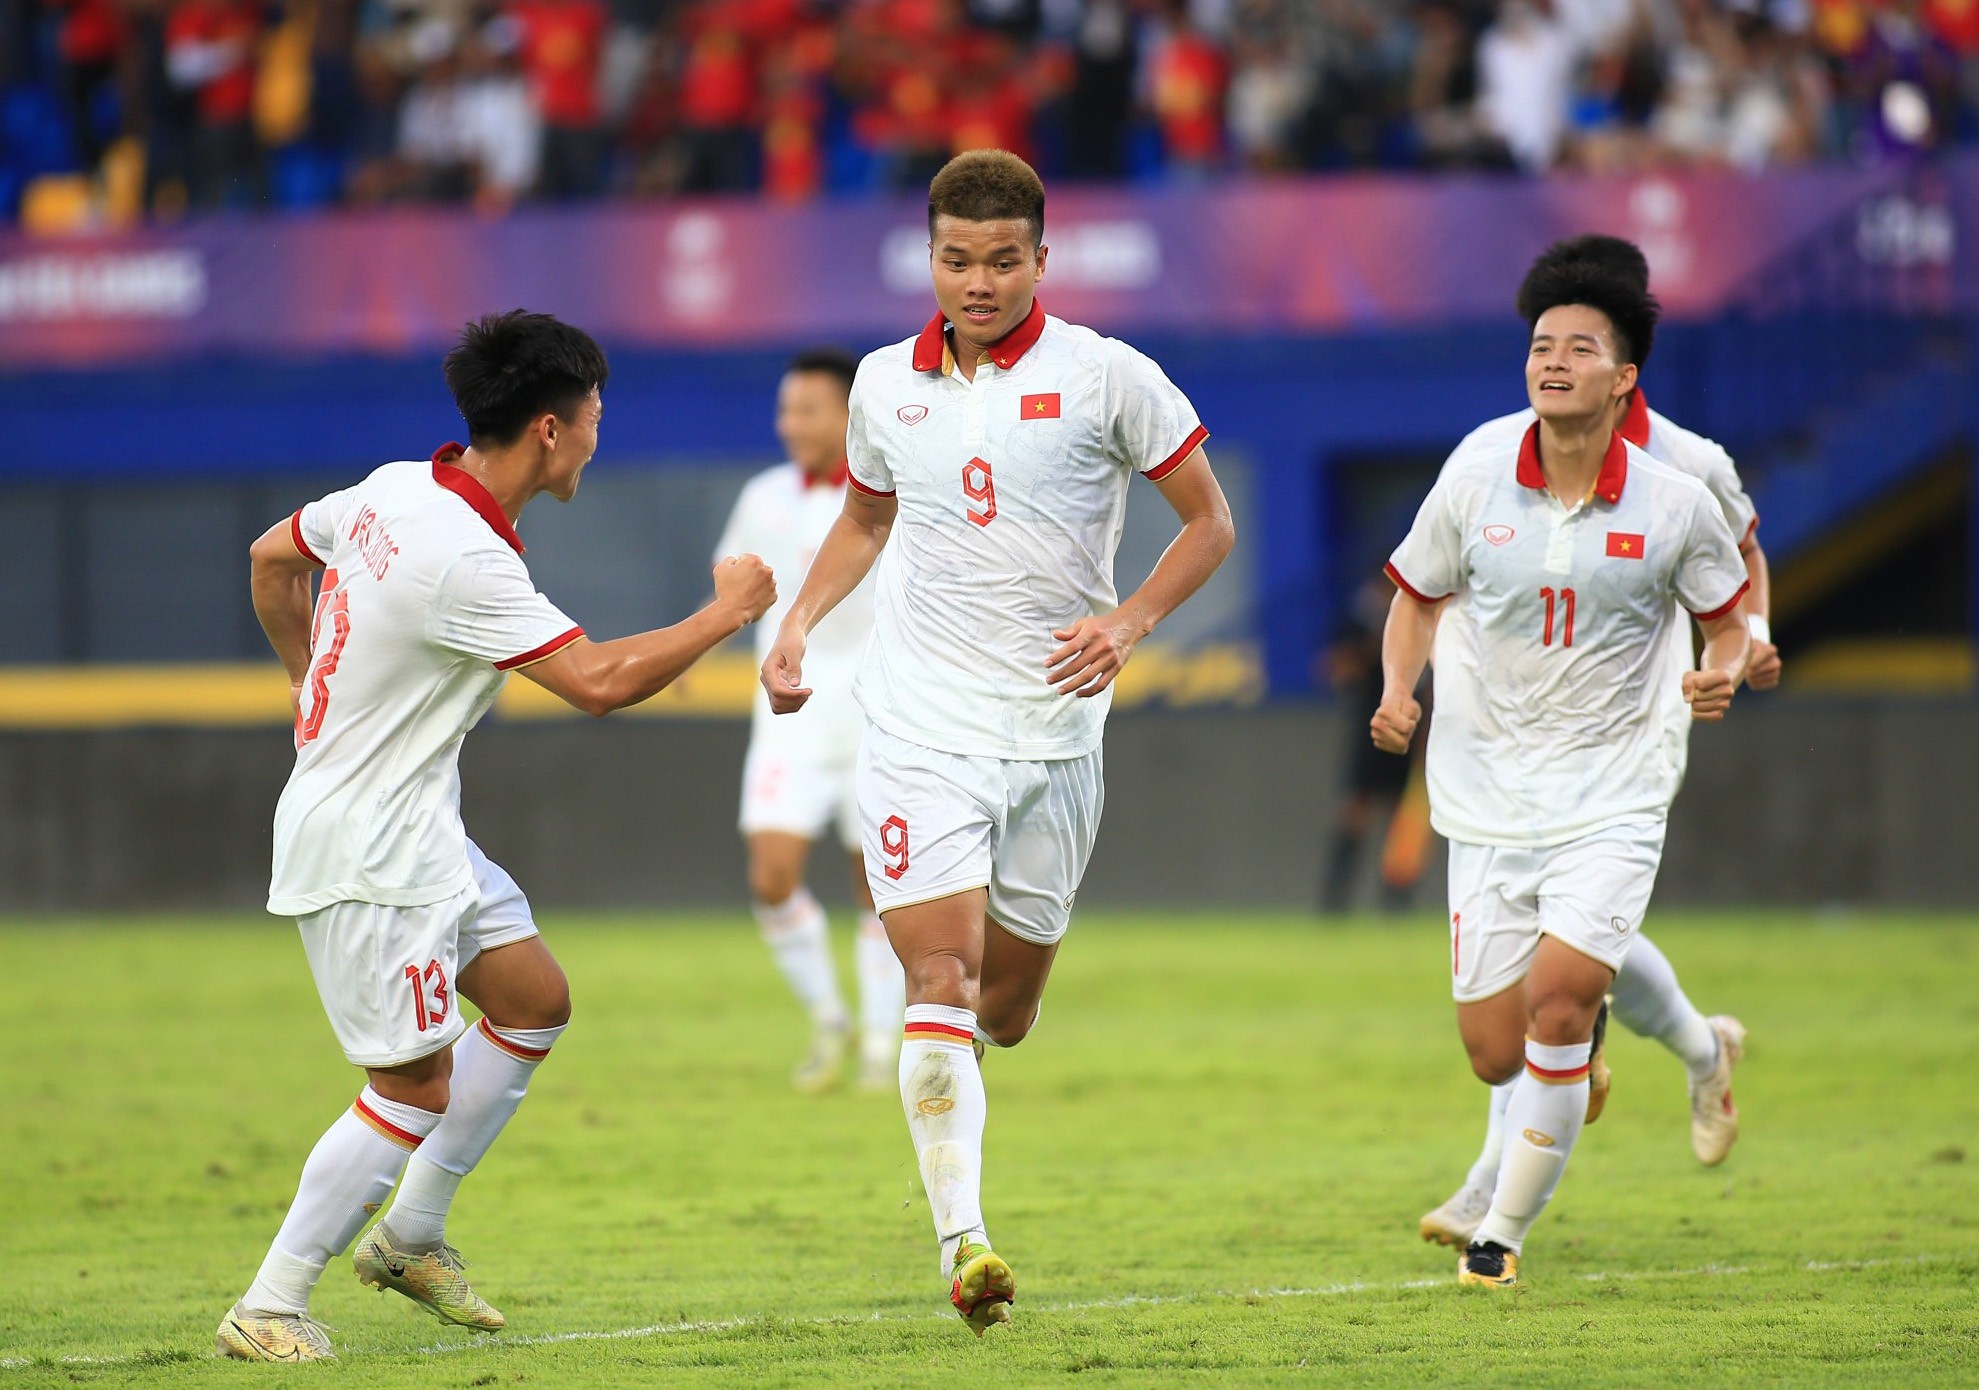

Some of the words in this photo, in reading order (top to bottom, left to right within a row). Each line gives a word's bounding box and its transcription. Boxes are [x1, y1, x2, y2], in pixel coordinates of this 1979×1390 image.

[961, 456, 998, 528] 9
[1539, 586, 1576, 648] 11
[879, 814, 910, 881] 9
[404, 958, 449, 1032] 13
